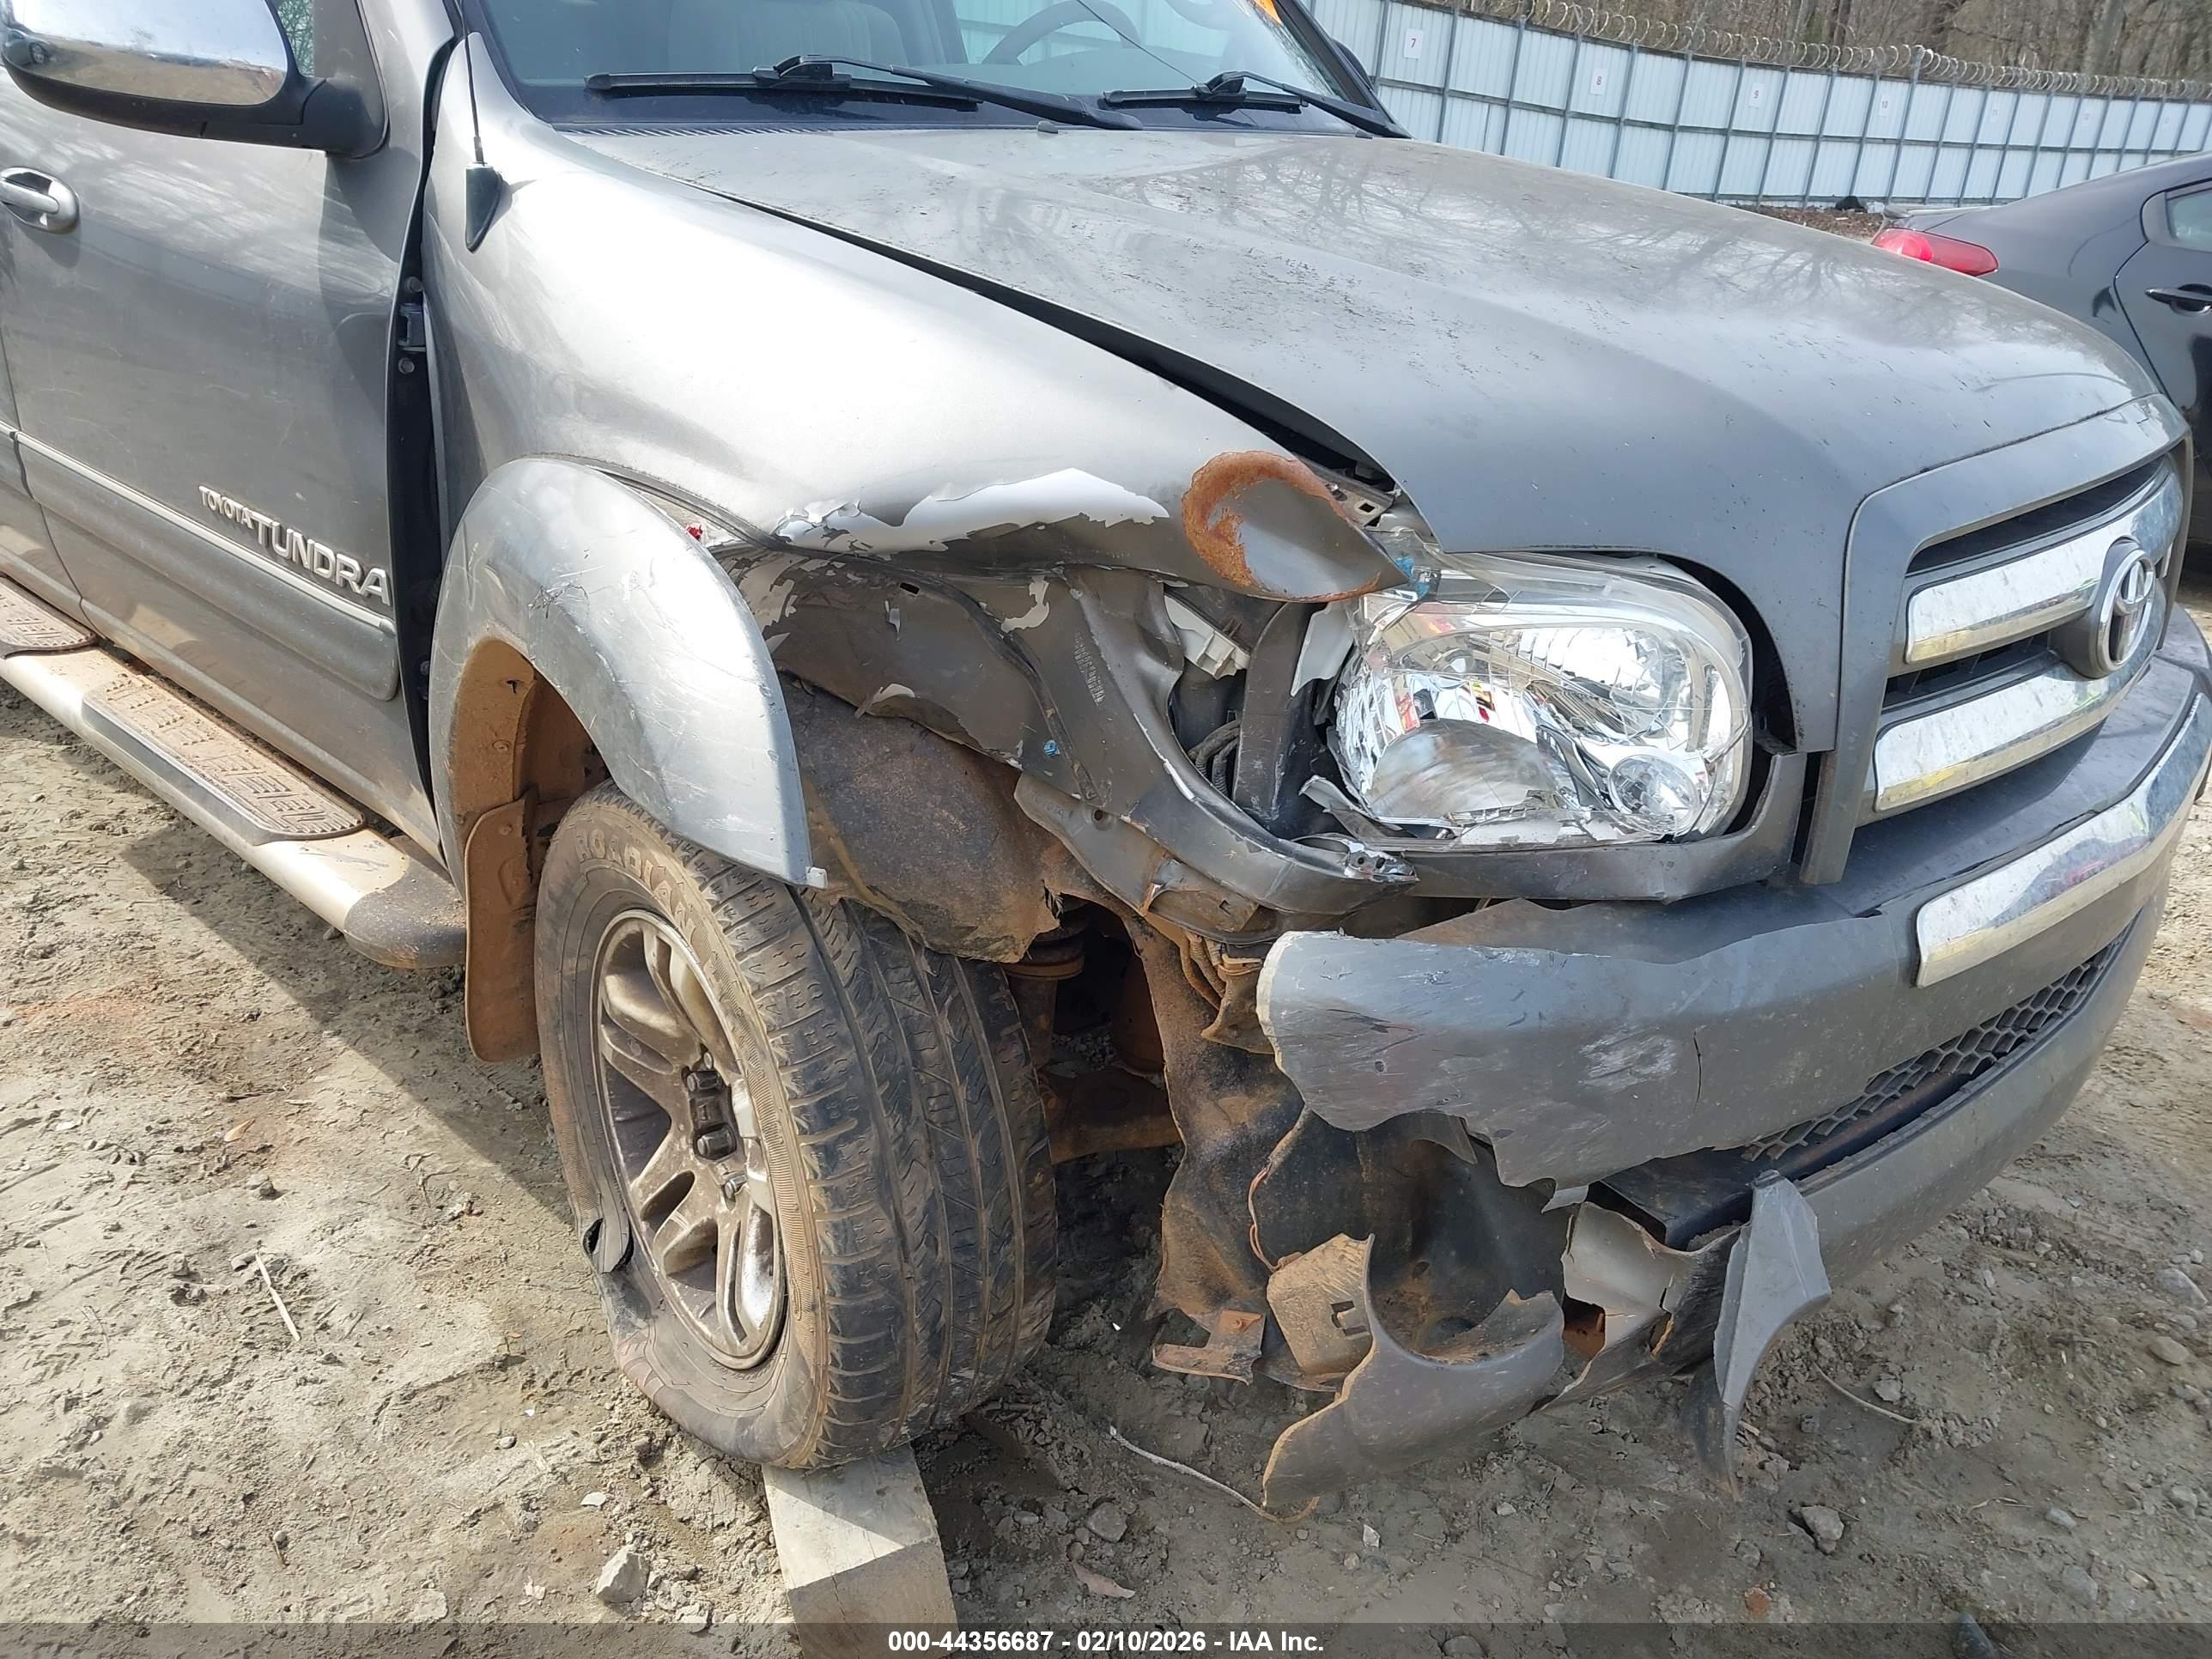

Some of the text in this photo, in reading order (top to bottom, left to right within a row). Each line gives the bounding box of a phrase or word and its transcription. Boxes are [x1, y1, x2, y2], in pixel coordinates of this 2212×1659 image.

[1411, 38, 1417, 48] 7
[1596, 76, 1602, 86] 8
[198, 485, 392, 605] TOYOTA TUNDRA
